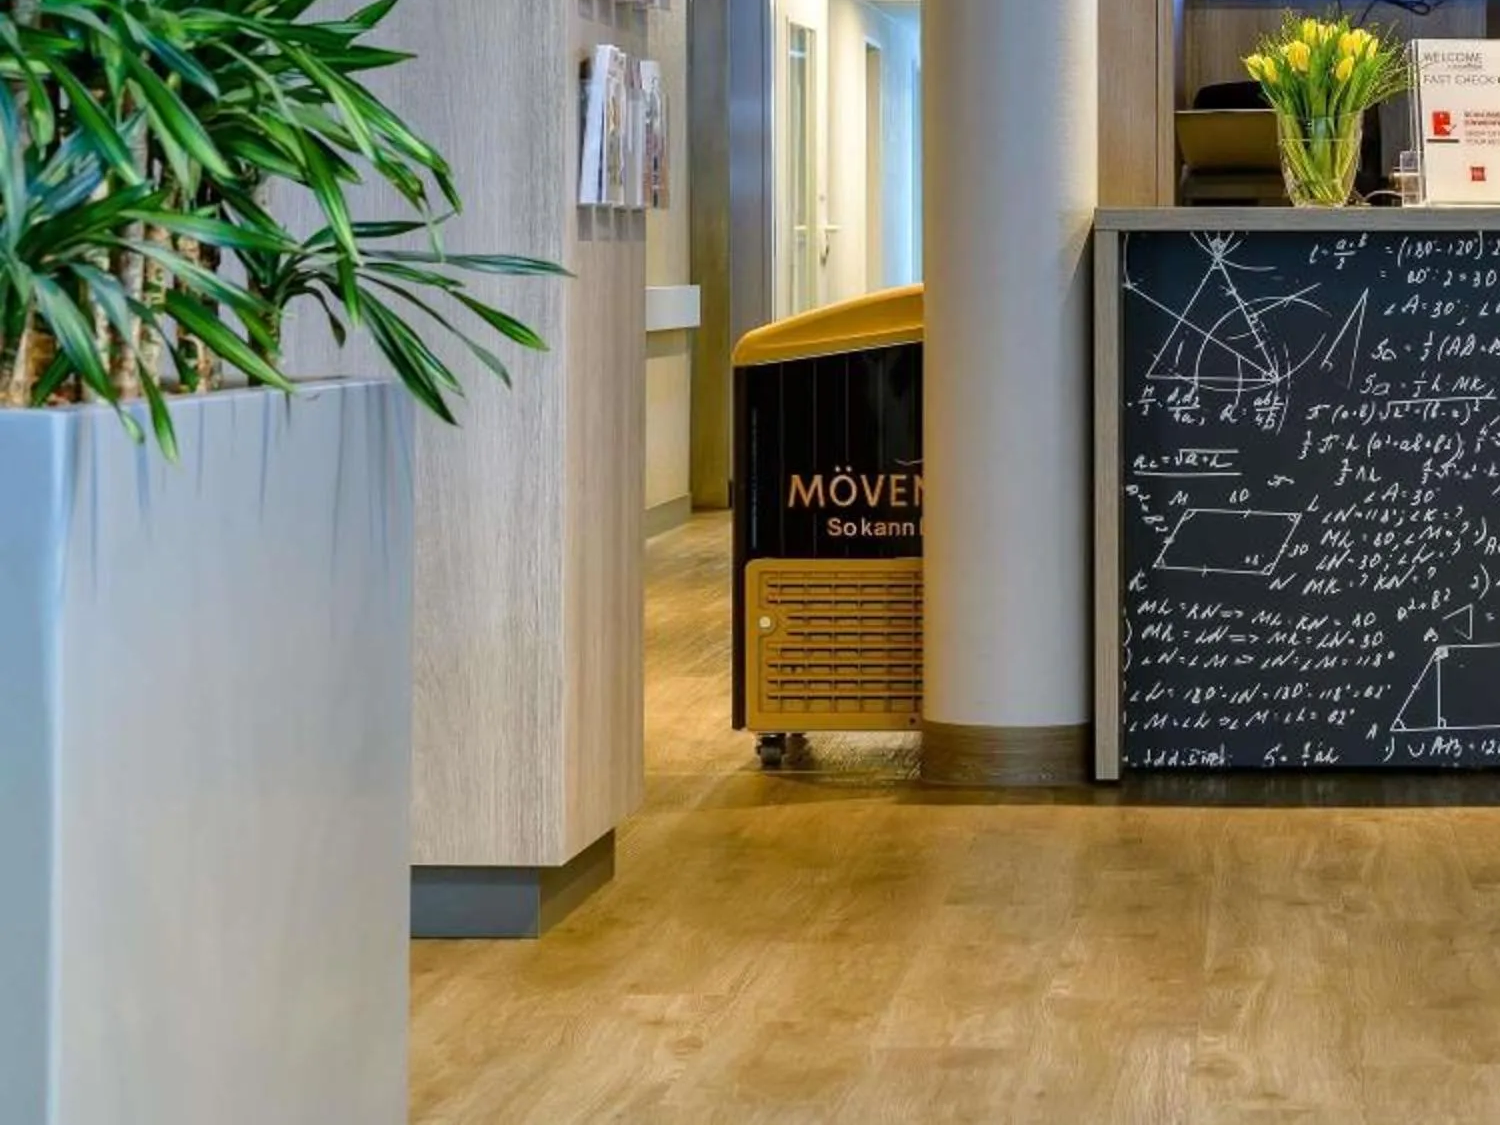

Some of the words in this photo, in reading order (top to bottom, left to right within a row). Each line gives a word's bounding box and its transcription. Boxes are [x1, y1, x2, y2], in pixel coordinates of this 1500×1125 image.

[1423, 52, 1483, 63] WELCOME
[1423, 75, 1451, 85] FAST
[1454, 75, 1496, 85] CHECK
[827, 518, 857, 536] So
[861, 516, 915, 536] kann
